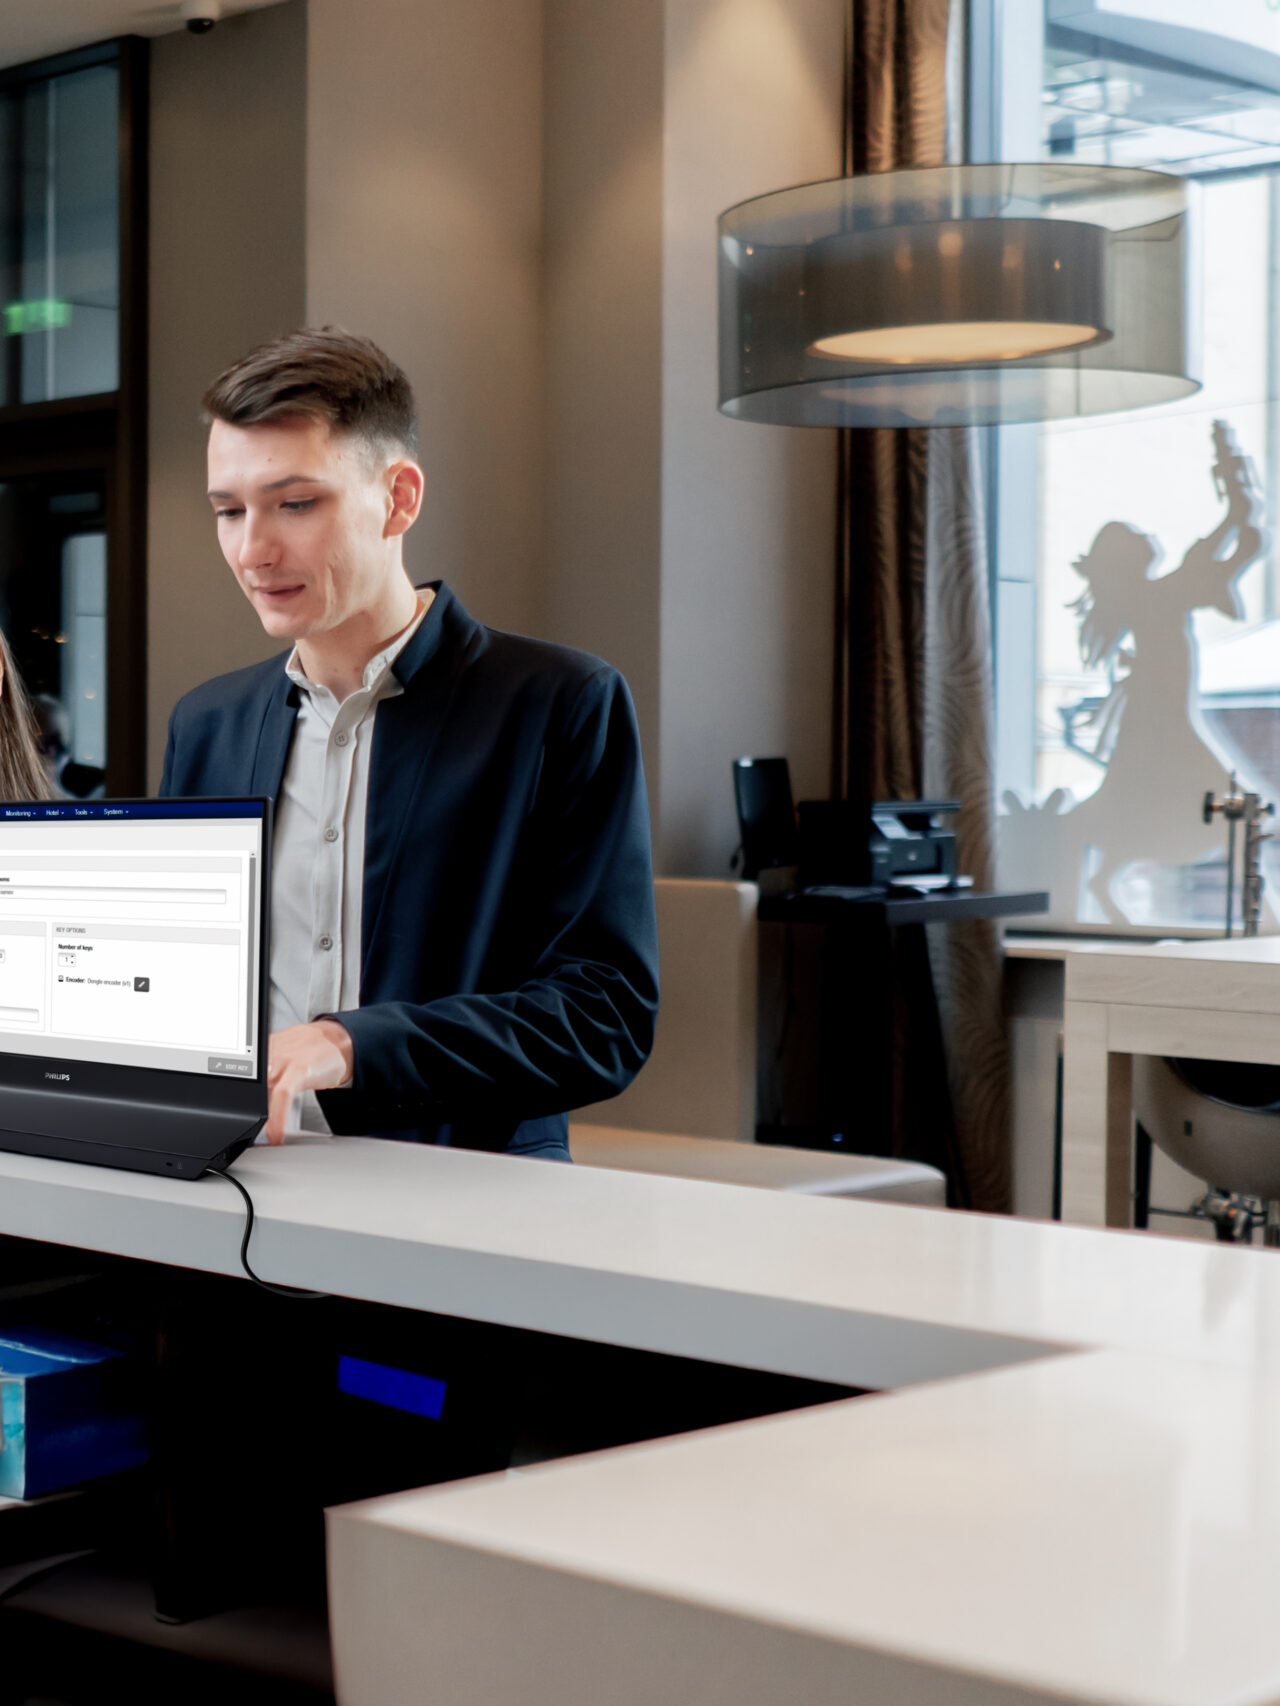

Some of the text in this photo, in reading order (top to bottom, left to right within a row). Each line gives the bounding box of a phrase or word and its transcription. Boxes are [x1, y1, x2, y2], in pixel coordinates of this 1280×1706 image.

[103, 808, 123, 816] System
[82, 944, 93, 952] keys
[65, 976, 85, 984] Encoder:
[45, 1072, 70, 1081] PHILIPS
